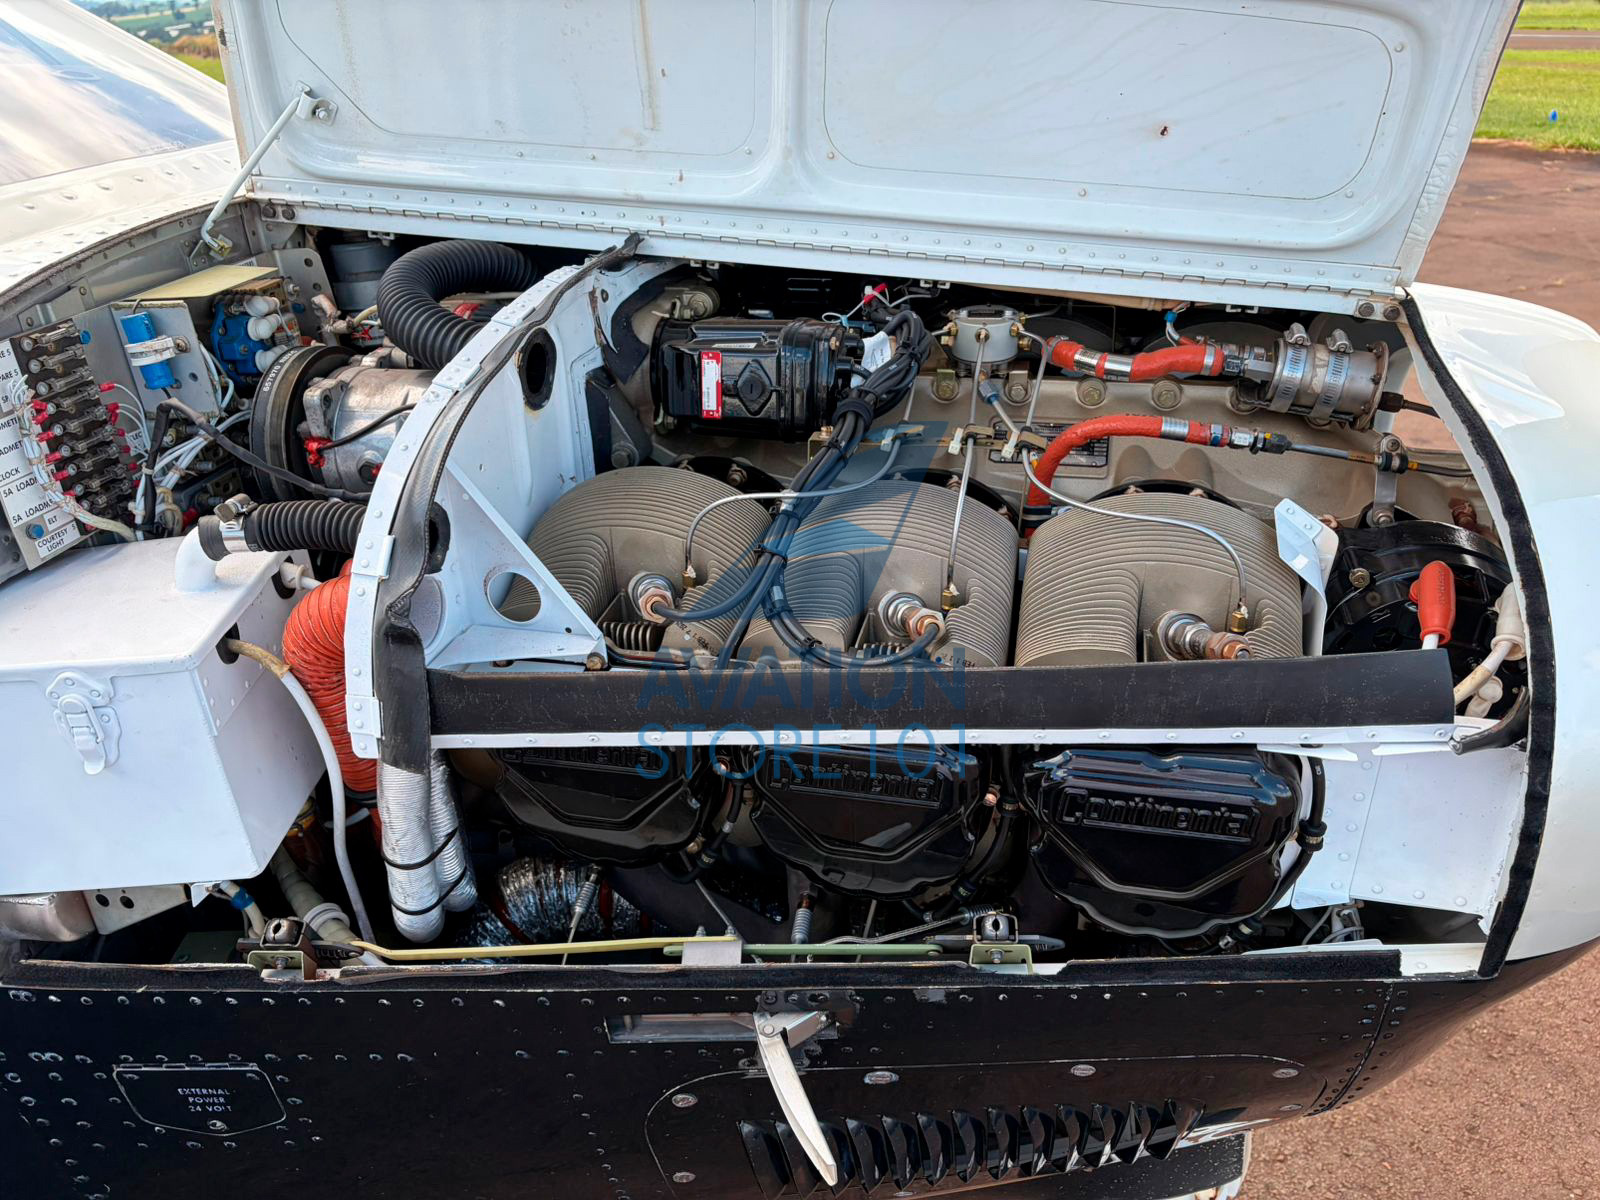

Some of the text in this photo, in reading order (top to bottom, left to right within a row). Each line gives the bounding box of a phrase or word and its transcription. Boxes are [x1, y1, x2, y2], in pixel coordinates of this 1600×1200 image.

[3, 488, 13, 498] 5A
[12, 514, 23, 525] 5A
[47, 515, 58, 525] ELT
[37, 527, 68, 549] COURTESY
[46, 538, 65, 553] LIGHT
[1057, 786, 1260, 838] Continental
[177, 1087, 231, 1096] EXTERNAL
[188, 1096, 226, 1104] POWER
